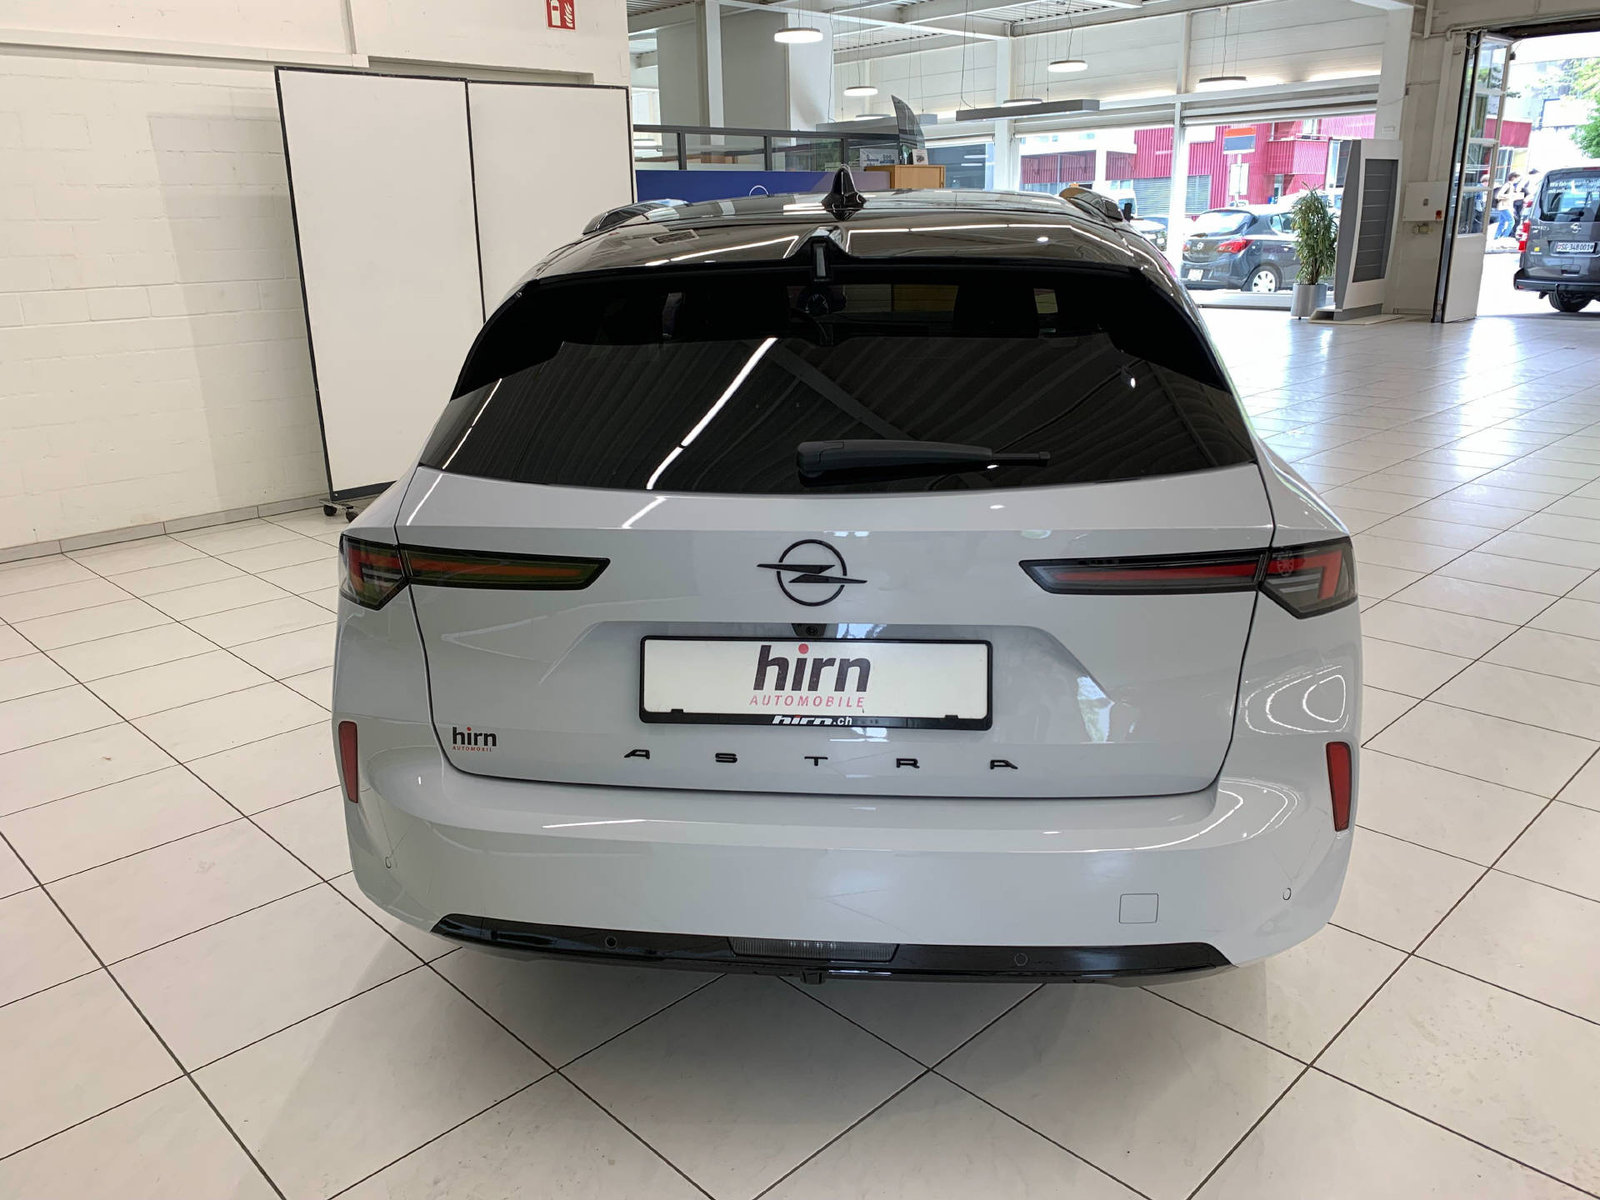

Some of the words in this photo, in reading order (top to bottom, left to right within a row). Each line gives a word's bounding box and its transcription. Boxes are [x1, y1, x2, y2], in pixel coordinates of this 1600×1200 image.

[753, 643, 871, 692] hirn
[749, 694, 865, 708] AUTOMOBILE
[772, 714, 853, 726] hirn.ch
[452, 726, 497, 747] hirn
[624, 748, 1018, 771] ASTRA
